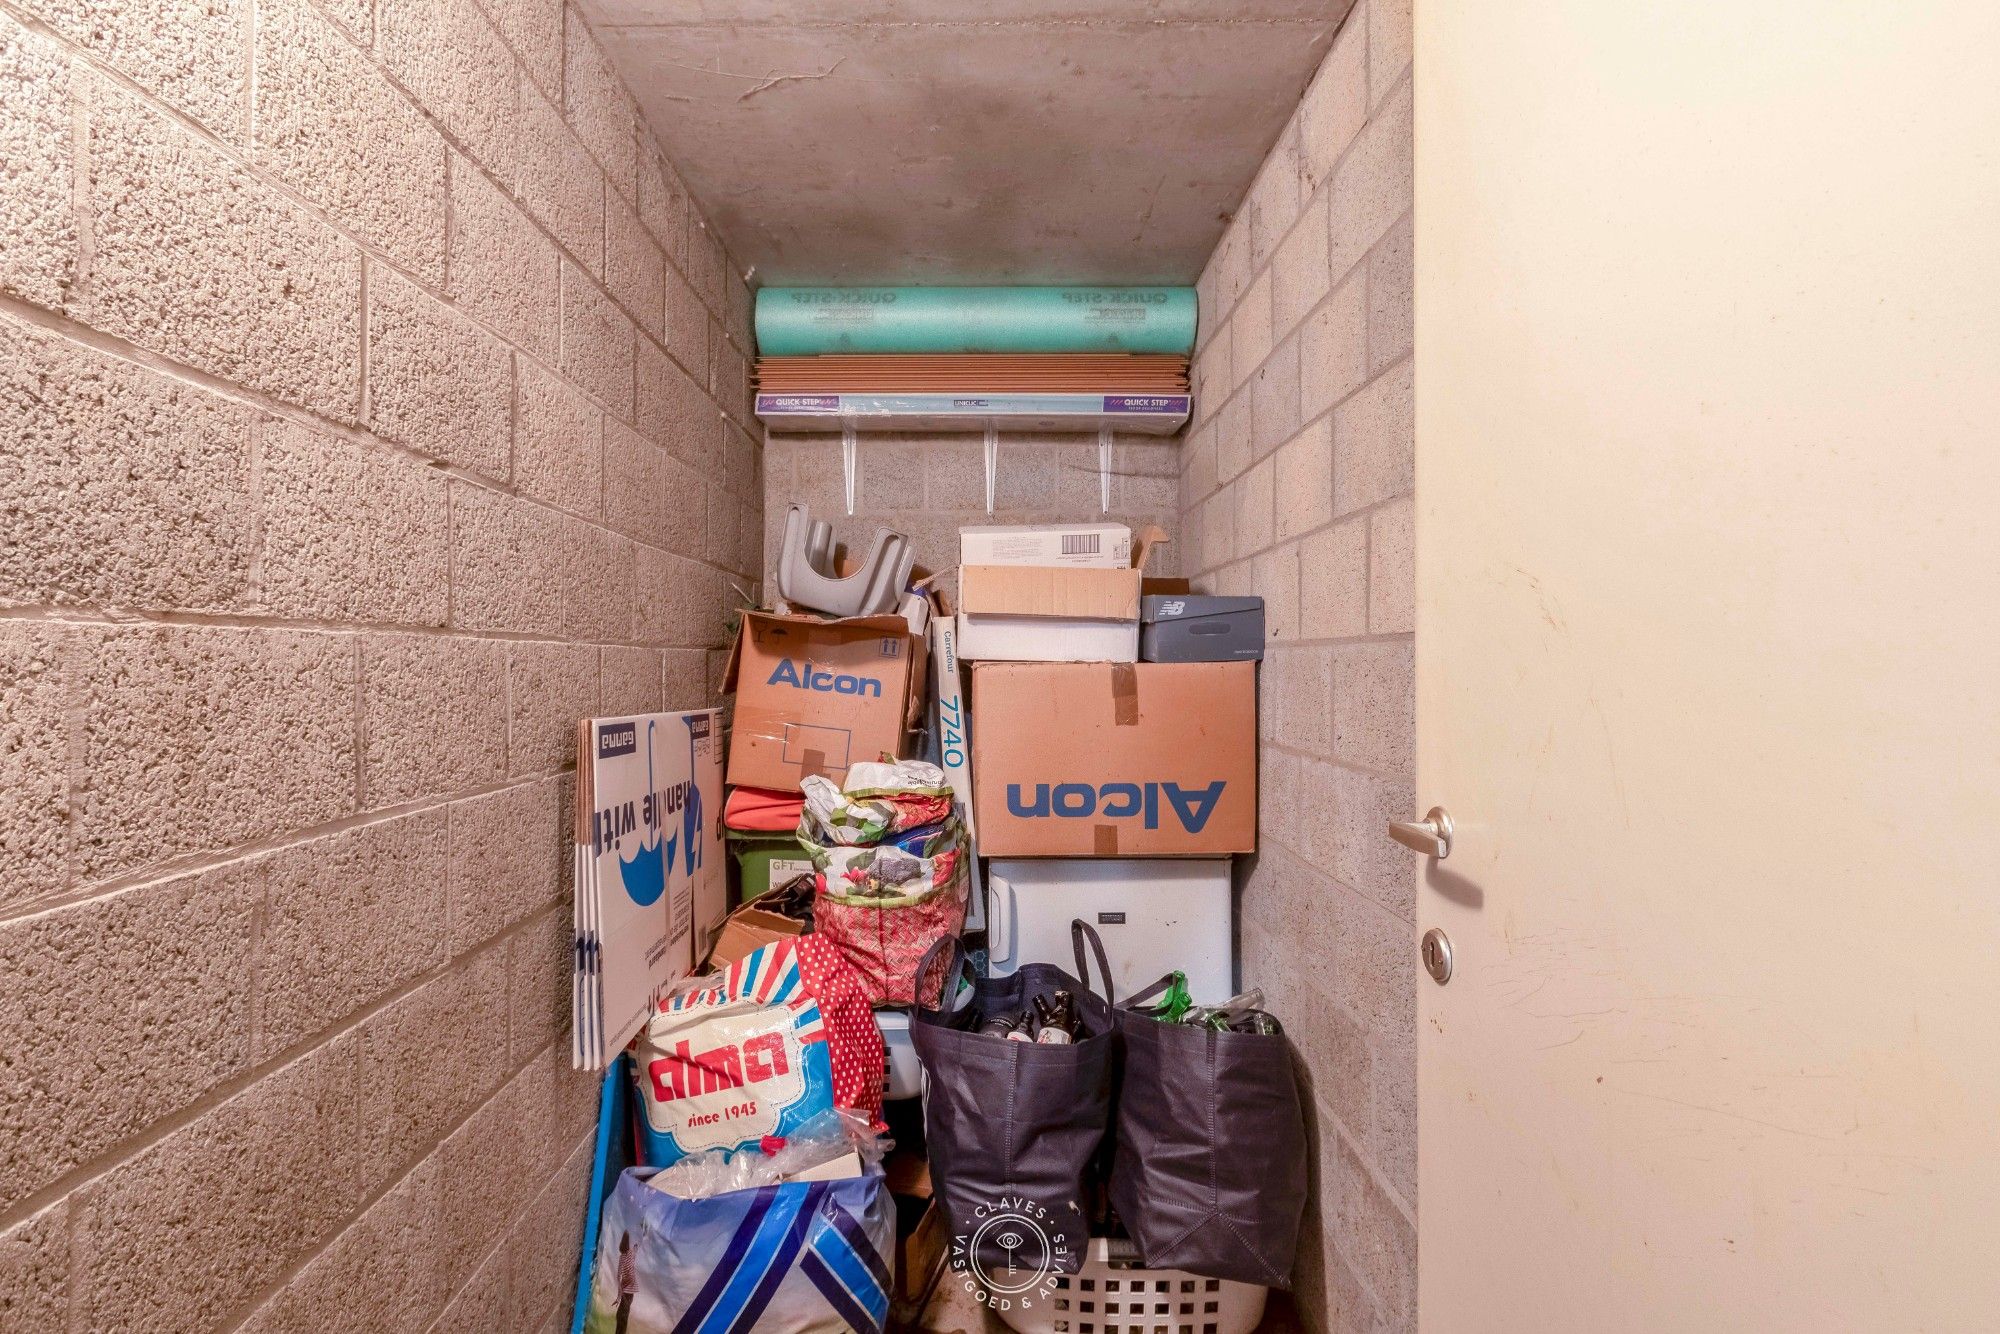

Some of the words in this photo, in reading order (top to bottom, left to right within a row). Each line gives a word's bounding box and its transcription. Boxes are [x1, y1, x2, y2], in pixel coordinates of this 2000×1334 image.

[776, 398, 800, 406] QUICK
[1124, 398, 1149, 406] QUICK
[943, 630, 954, 674] Carrefour
[766, 658, 882, 698] Alcon
[940, 695, 964, 768] 7740
[1006, 780, 1227, 834] Alcon
[772, 860, 795, 871] GFT
[688, 1113, 720, 1128] since
[724, 1101, 757, 1121] 1945
